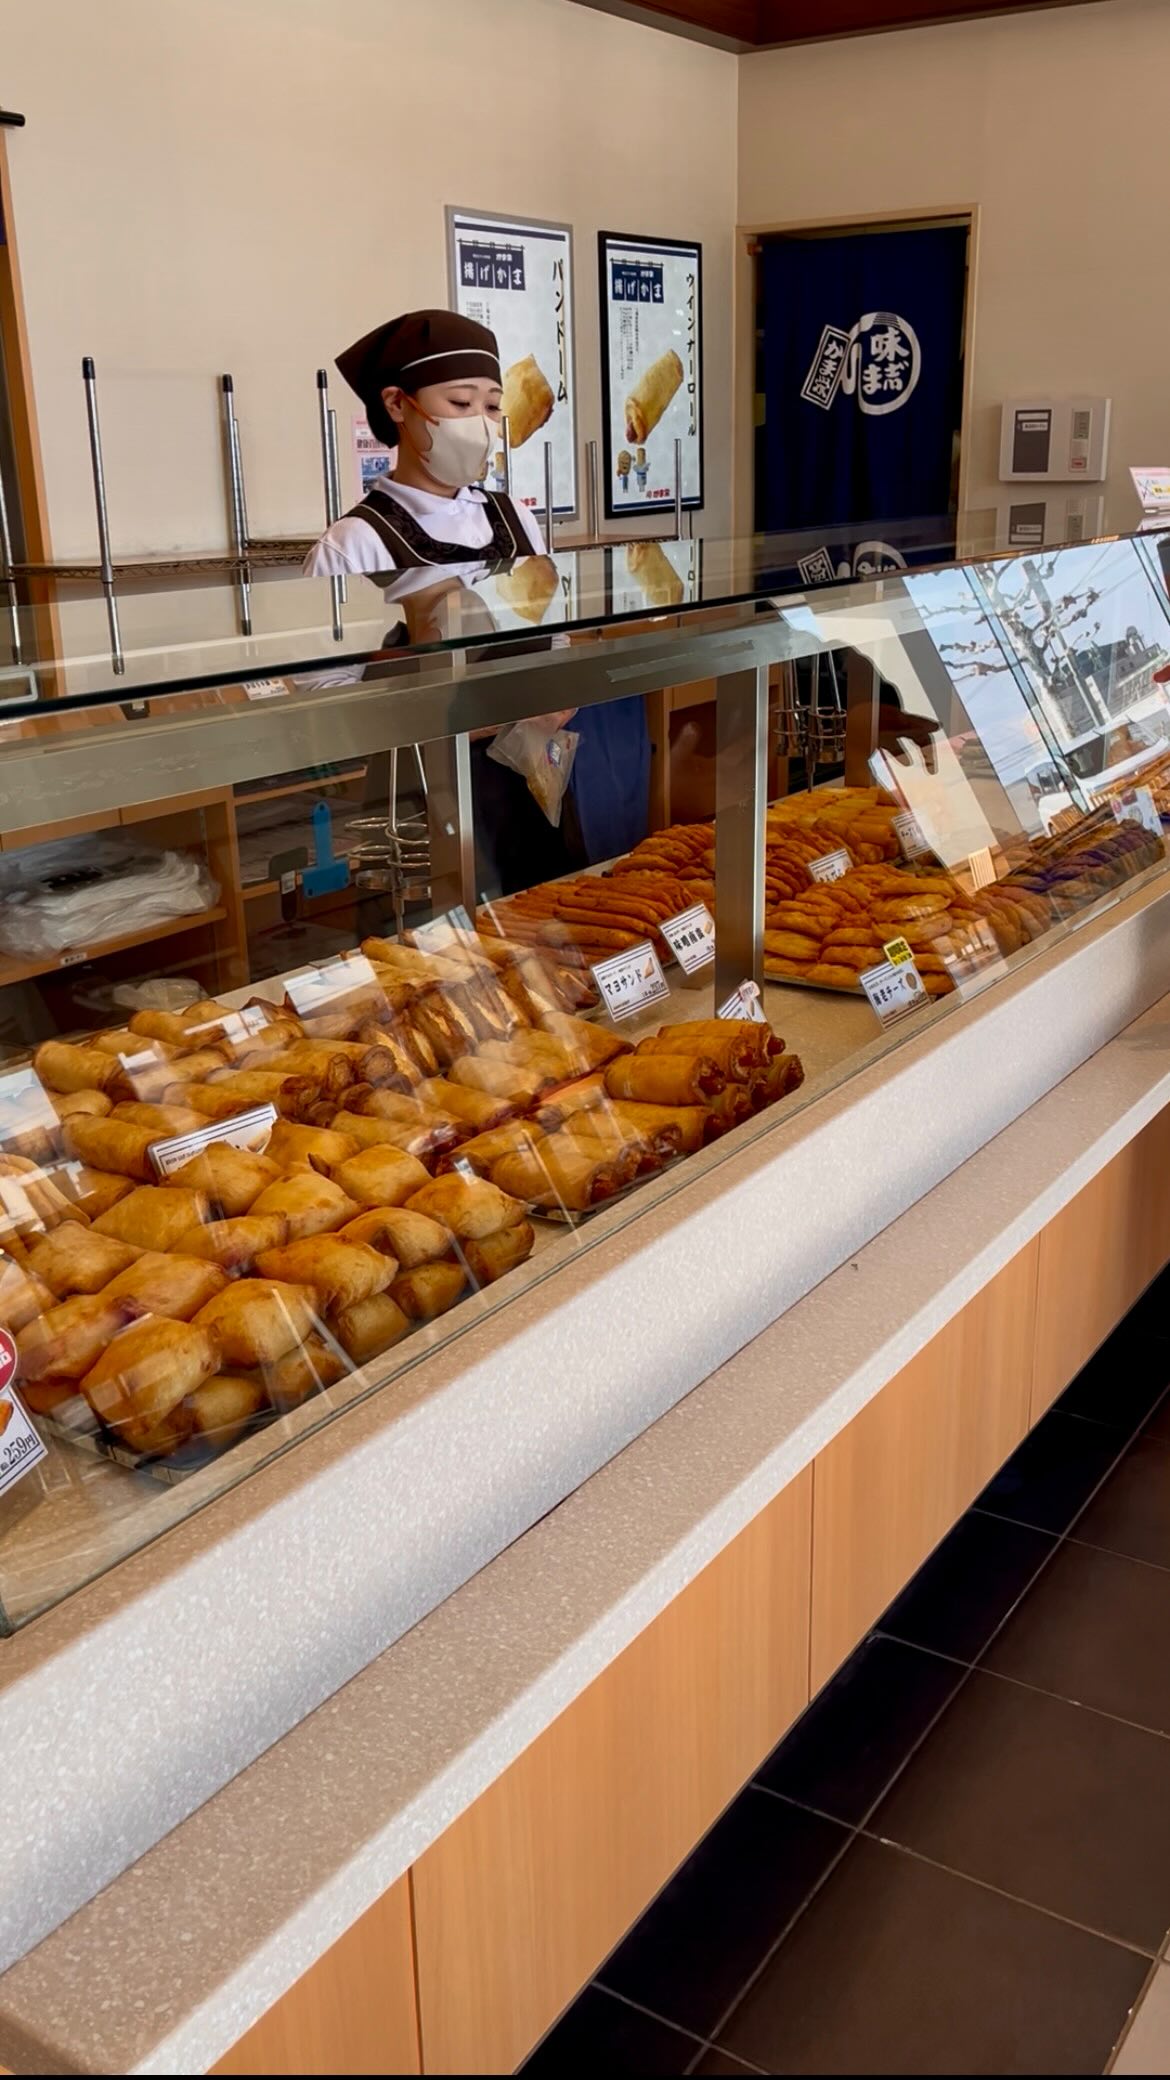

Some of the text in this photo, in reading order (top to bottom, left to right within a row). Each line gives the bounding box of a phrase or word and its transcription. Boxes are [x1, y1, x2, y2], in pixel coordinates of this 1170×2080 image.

[552, 258, 568, 403] パンドーム
[605, 968, 642, 995] マヨサンド
[4, 1433, 36, 1465] 259円
